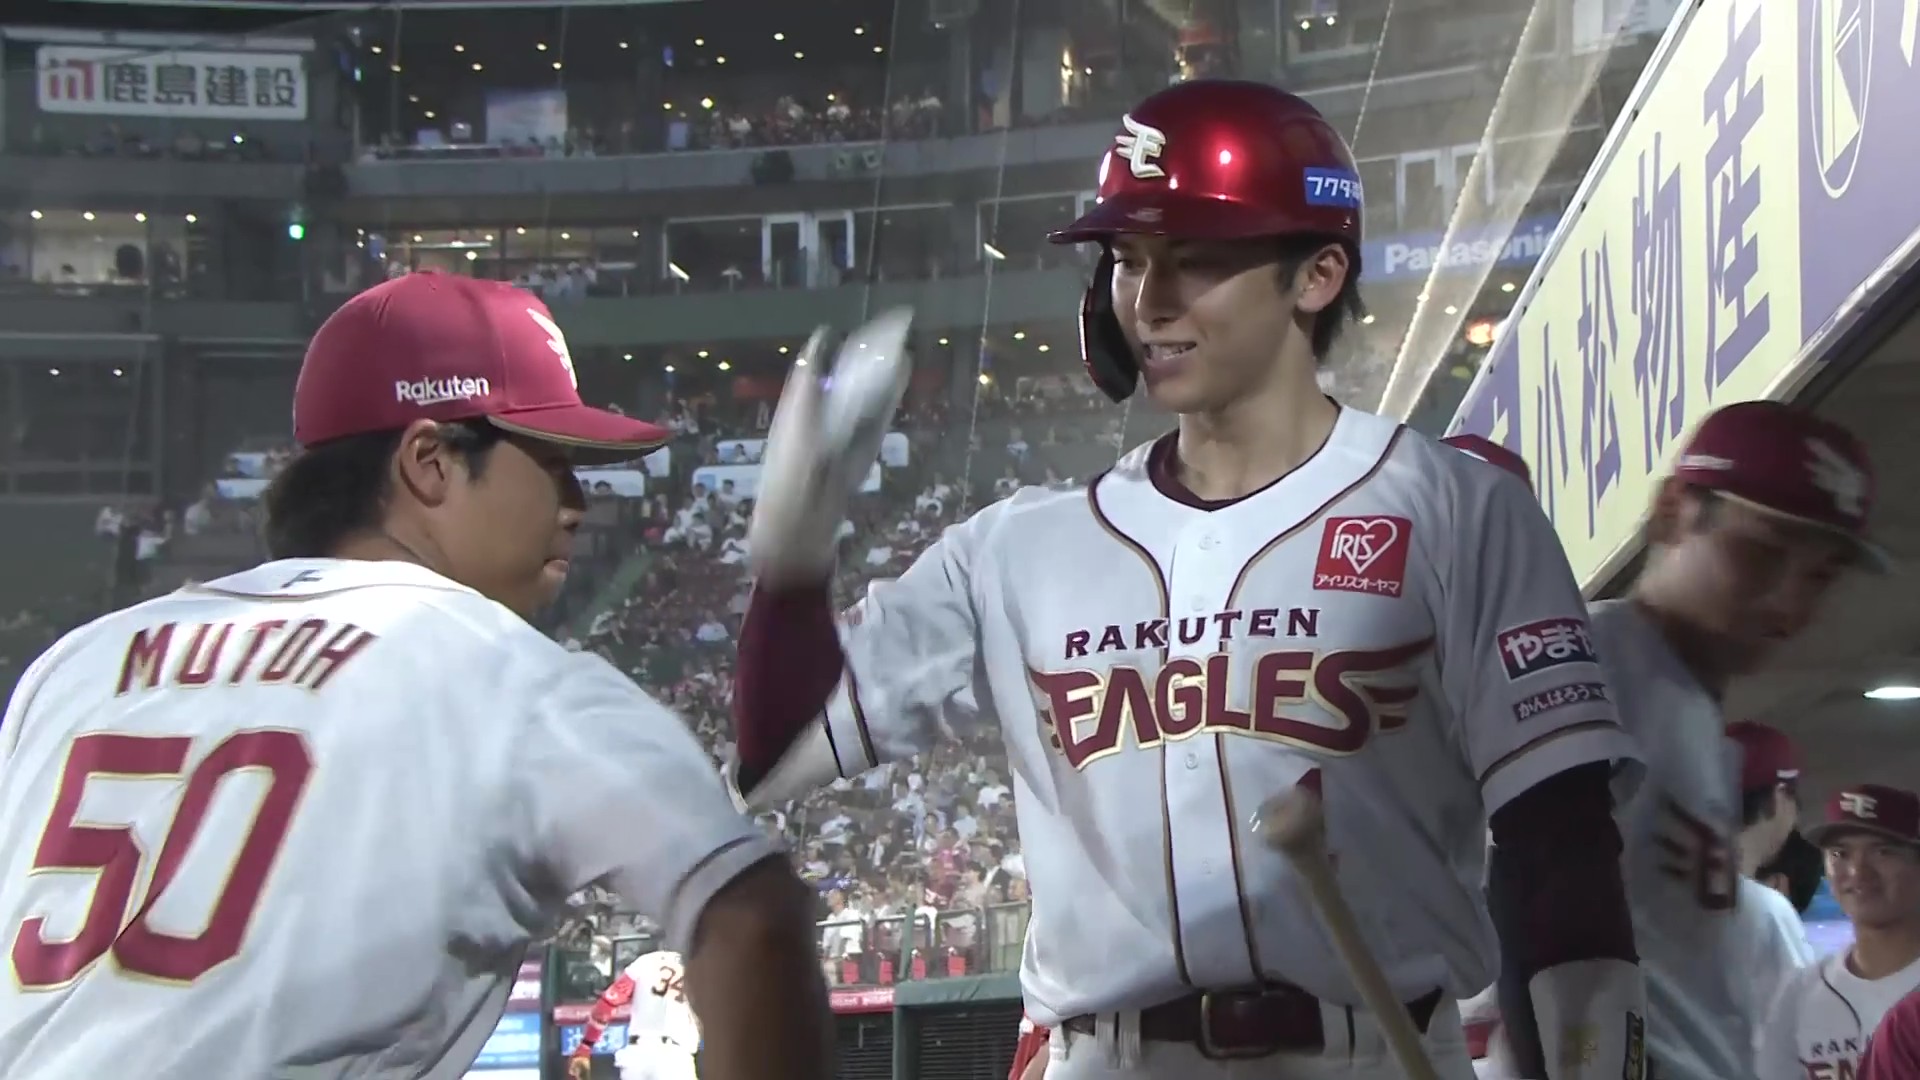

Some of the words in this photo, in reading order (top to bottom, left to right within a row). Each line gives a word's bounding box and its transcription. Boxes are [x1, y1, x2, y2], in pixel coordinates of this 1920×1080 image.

[104, 62, 297, 108] 鹿島建設
[1384, 226, 1555, 274] Panasoni
[396, 375, 490, 406] Rakuten
[1330, 532, 1376, 560] IRIS
[1314, 573, 1401, 595] アイリスオーヤマ
[1064, 607, 1322, 660] RAKUTEN
[113, 618, 381, 699] MUTOH
[1030, 638, 1430, 771] EAGLES
[11, 726, 318, 992] 50
